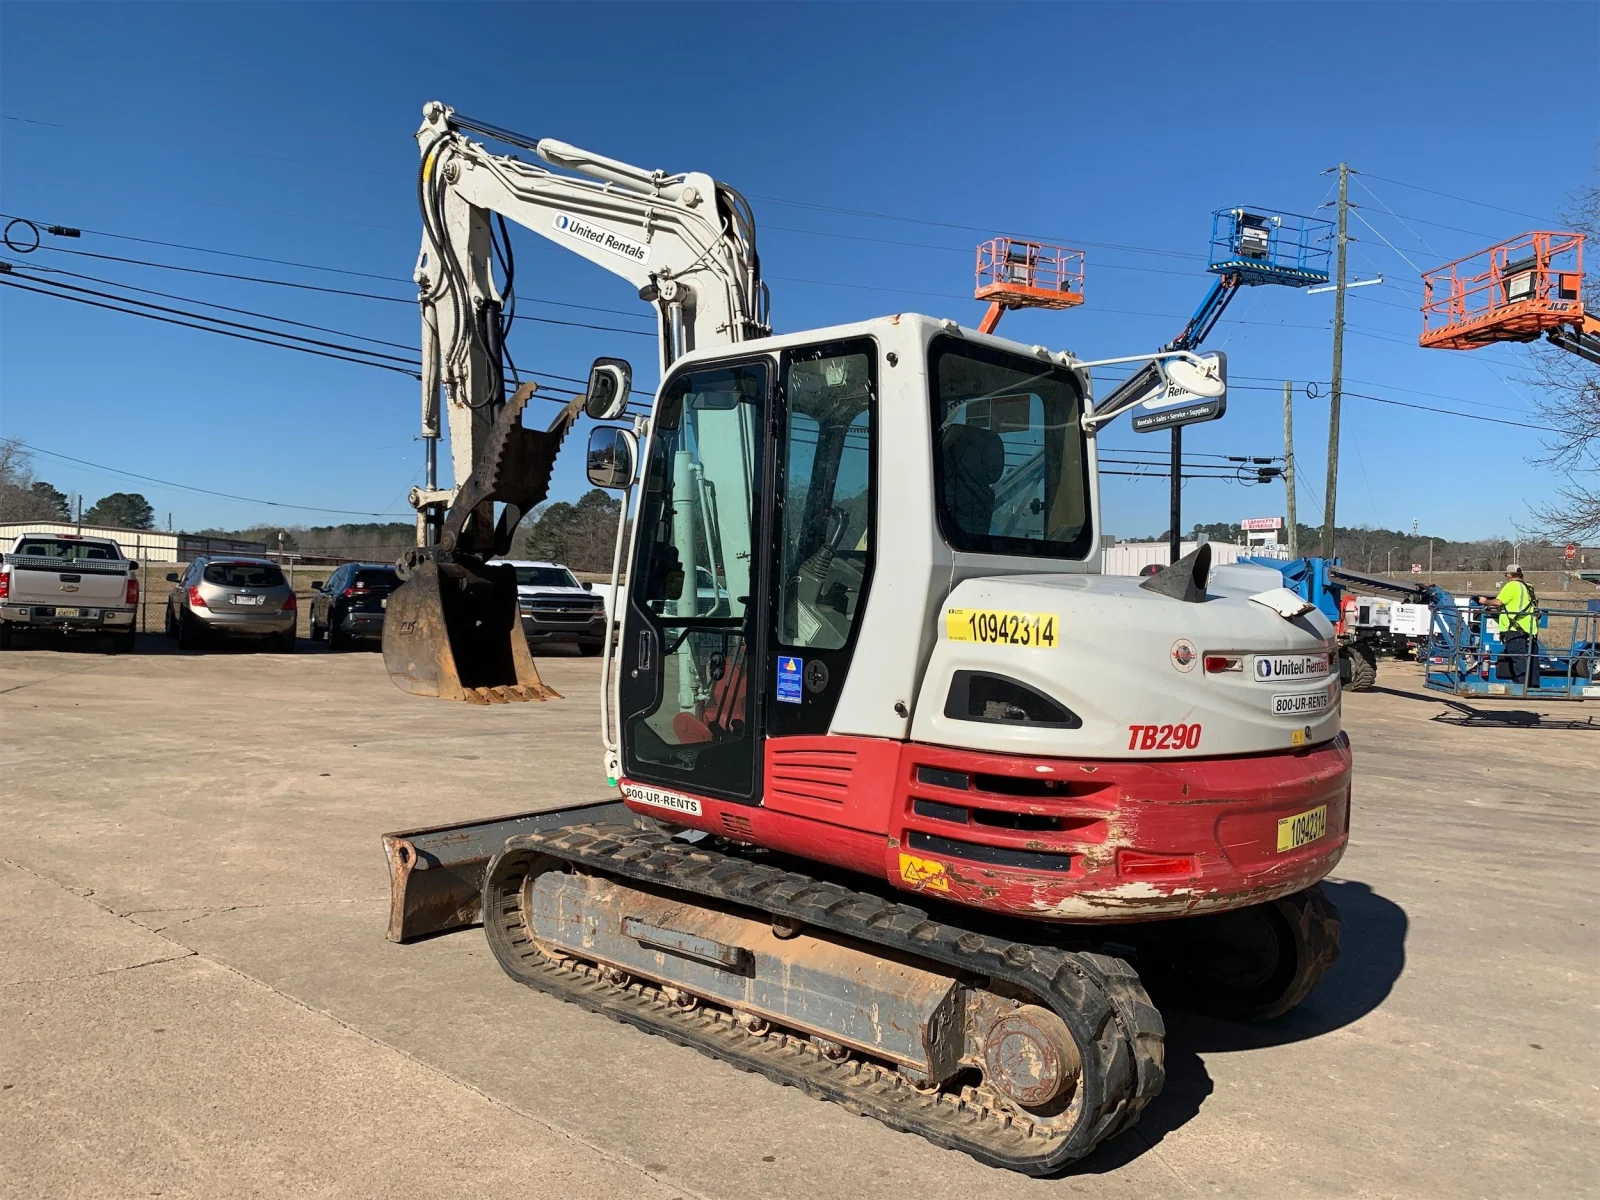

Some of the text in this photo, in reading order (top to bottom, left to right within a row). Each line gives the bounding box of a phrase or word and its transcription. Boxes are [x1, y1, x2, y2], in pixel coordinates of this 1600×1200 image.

[569, 221, 645, 260] United Rentals
[1547, 302, 1569, 311] JLG
[1137, 407, 1209, 426] Rentals Sales Service Supplies
[969, 613, 1054, 646] 10942314
[1274, 658, 1327, 676] United Rentals
[1276, 695, 1327, 711] 800-UR-RENTS
[1128, 724, 1202, 750] TB290
[626, 787, 697, 812] 800-UR-RENTS
[1292, 807, 1325, 847] 10942314
